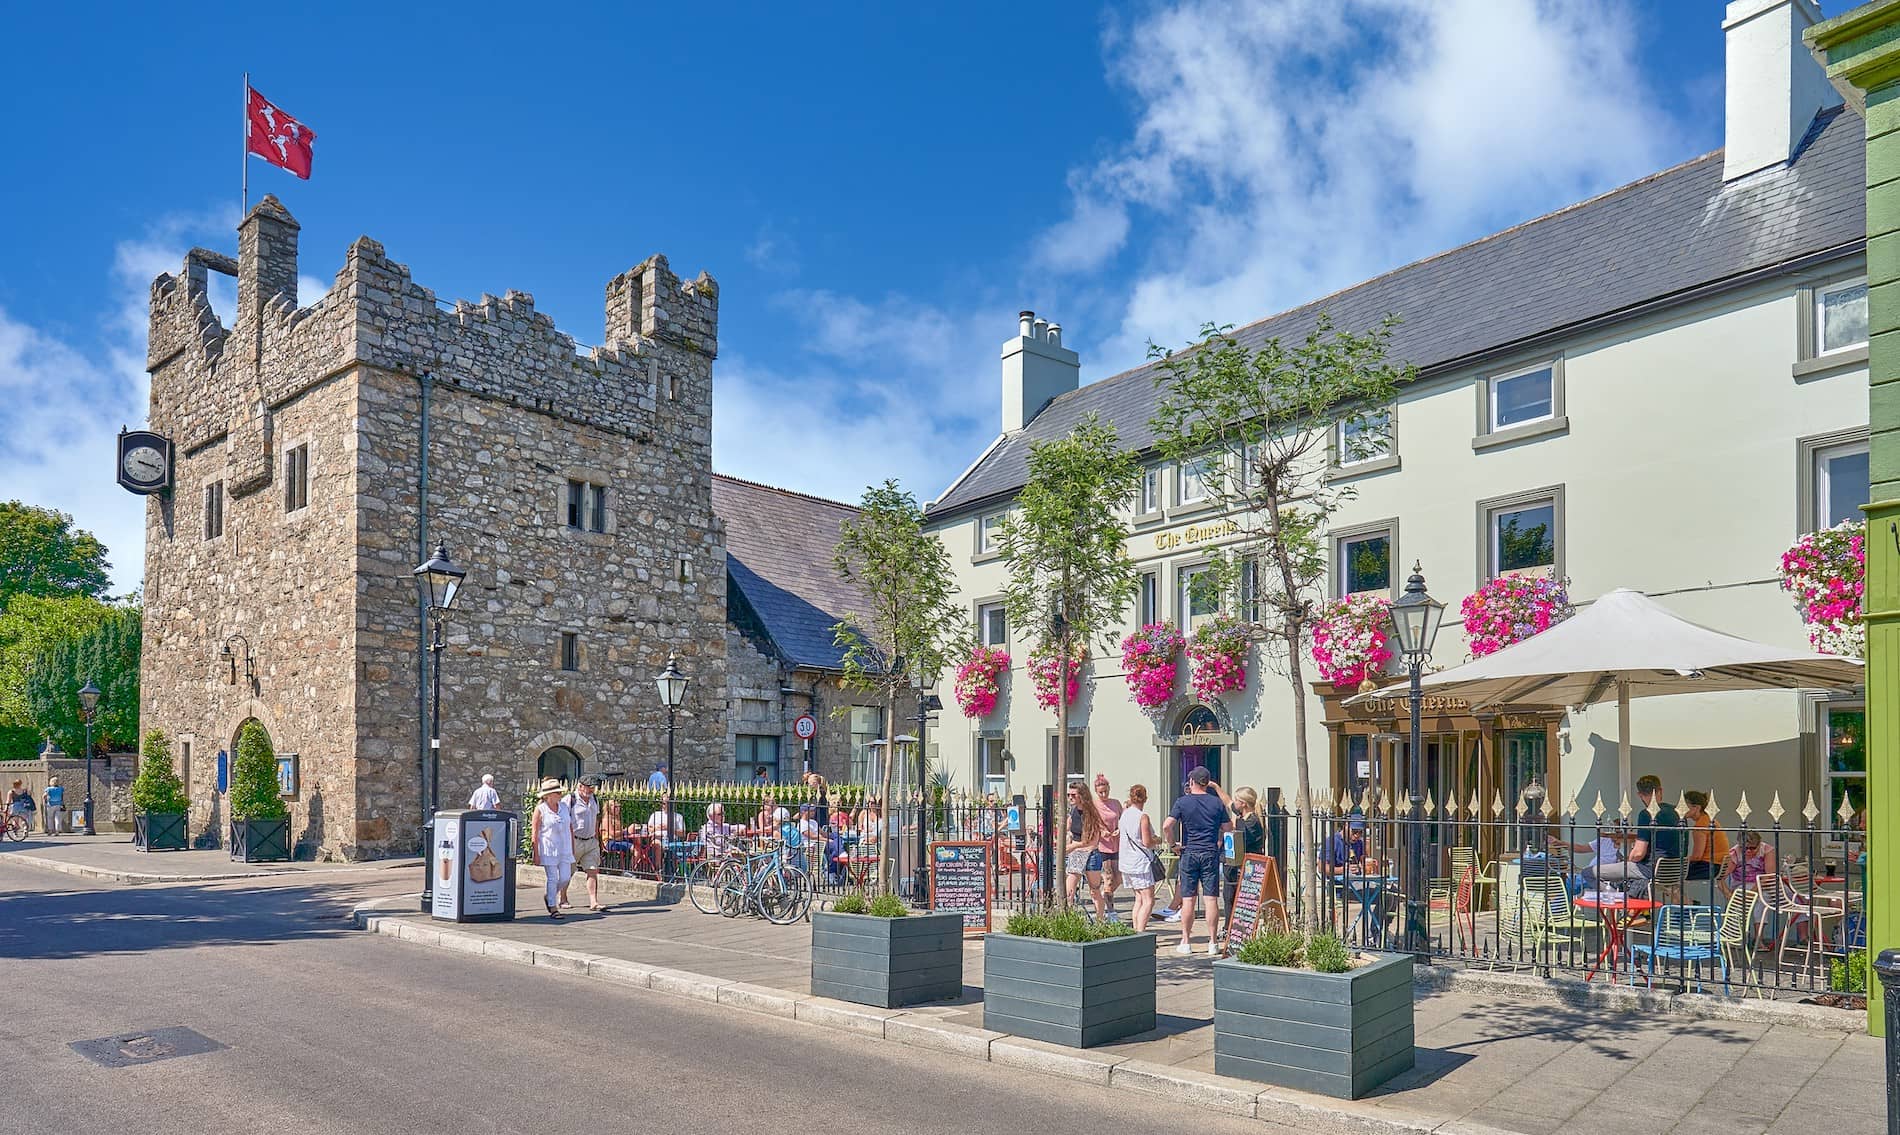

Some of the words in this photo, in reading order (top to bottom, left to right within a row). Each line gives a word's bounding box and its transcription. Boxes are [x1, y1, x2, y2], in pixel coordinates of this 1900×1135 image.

[1154, 531, 1181, 550] The
[1185, 522, 1237, 544] Queens
[800, 721, 811, 731] 30
